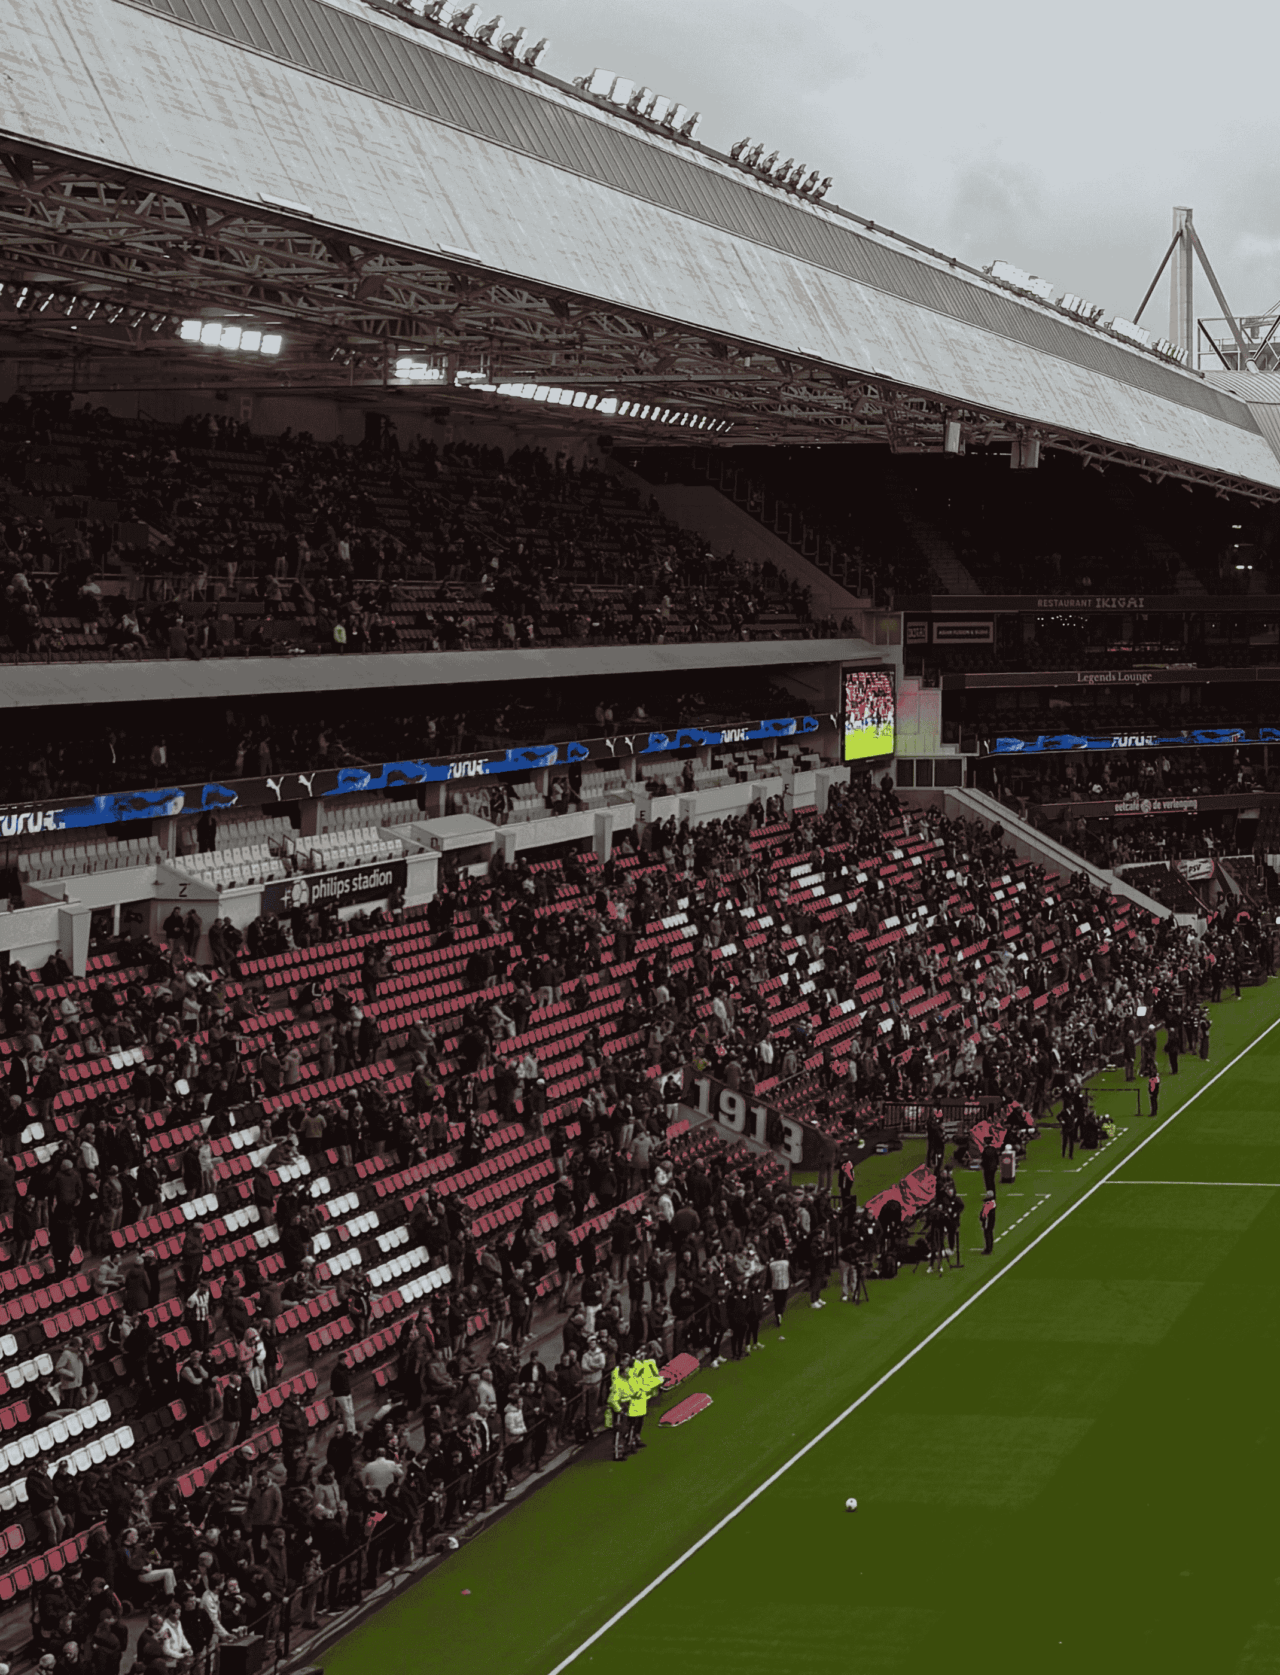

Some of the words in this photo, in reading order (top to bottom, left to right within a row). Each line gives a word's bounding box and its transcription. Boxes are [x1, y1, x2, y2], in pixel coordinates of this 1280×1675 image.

[1037, 598, 1092, 608] RESTAURANT
[1095, 597, 1145, 608] IKIGAI
[1077, 671, 1116, 682] Legends
[1118, 670, 1152, 682] Lounge
[178, 883, 188, 897] Z
[311, 875, 349, 904] philips
[351, 868, 393, 892] stadion
[693, 1076, 803, 1164] 1913
